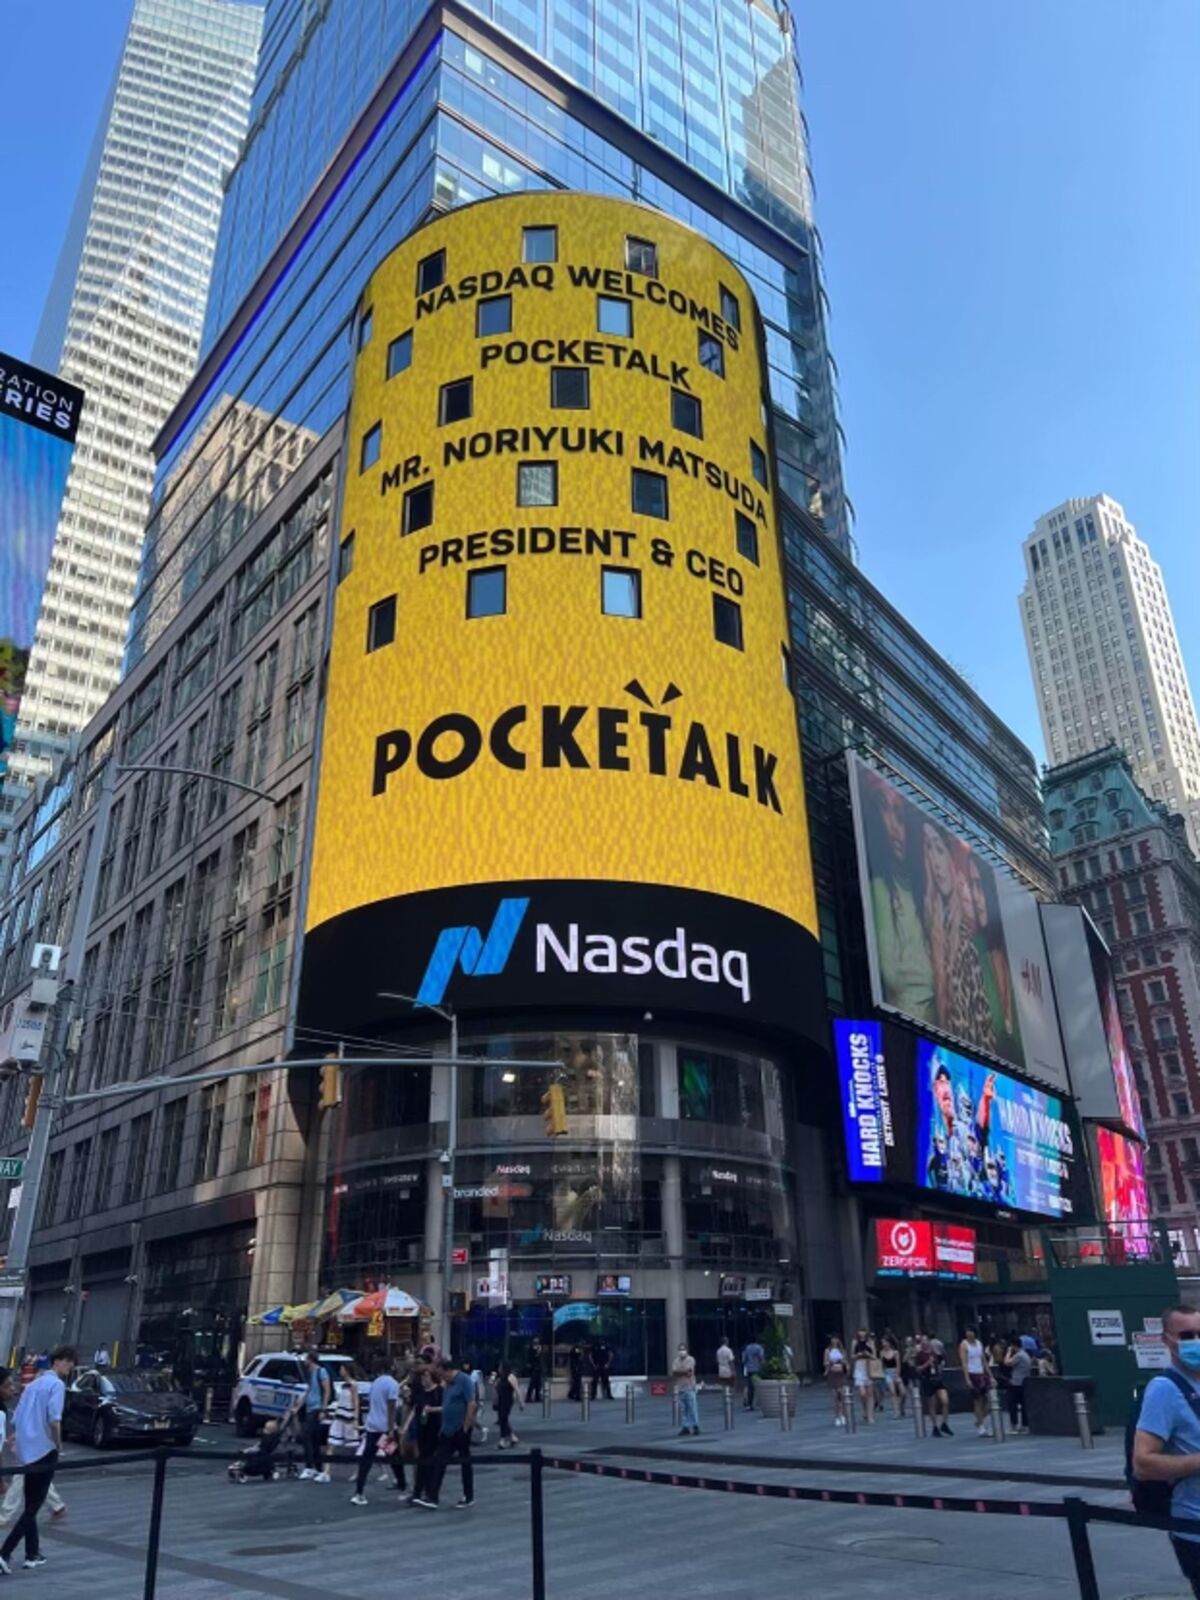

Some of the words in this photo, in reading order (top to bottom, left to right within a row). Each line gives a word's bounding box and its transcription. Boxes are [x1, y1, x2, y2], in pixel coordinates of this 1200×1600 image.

[416, 265, 554, 320] NASDAQ
[567, 264, 740, 351] WELCOMES
[480, 339, 691, 389] POCKETALK
[0, 384, 71, 430] RIES
[381, 455, 430, 497] MR.
[443, 426, 624, 466] NORIYUKI
[638, 435, 768, 529] MATSUDA
[418, 527, 636, 574] PRESIDENT
[650, 538, 675, 567] &
[686, 549, 744, 597] CEO
[372, 703, 784, 816] POCKETALK
[535, 922, 751, 1003] Nasdaq
[849, 1032, 875, 1110] KNOCKS
[858, 1114, 883, 1166] HARD
[453, 1185, 498, 1199] branded
[543, 1228, 592, 1244] Nasdaq
